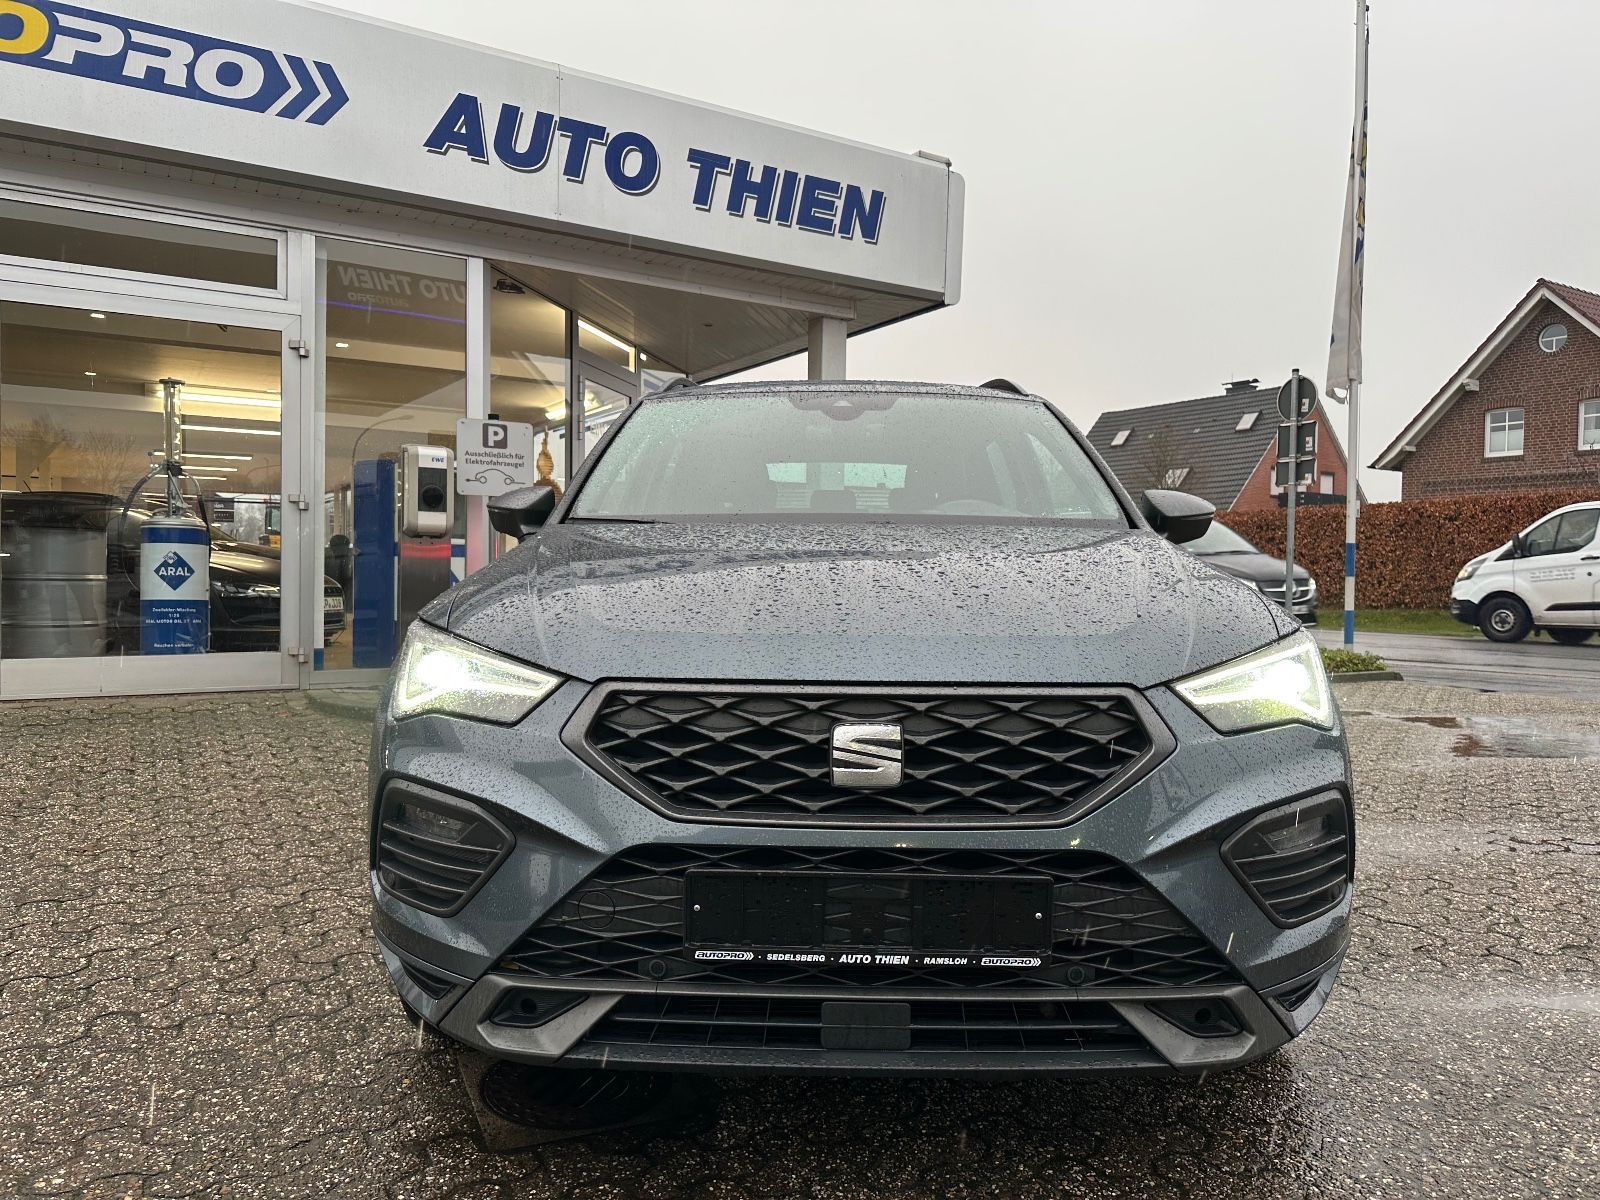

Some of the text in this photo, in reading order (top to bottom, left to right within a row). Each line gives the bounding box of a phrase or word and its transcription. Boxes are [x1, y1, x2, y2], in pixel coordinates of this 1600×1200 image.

[423, 92, 887, 246] AUTO THIEN
[487, 425, 505, 447] P
[464, 450, 514, 460] Ausschließlich
[159, 566, 191, 576] ARAL
[766, 953, 826, 962] SEDELSBERG
[838, 954, 872, 964] AUTO
[874, 955, 909, 965] THIEN
[923, 957, 968, 965] RAMSLOH
